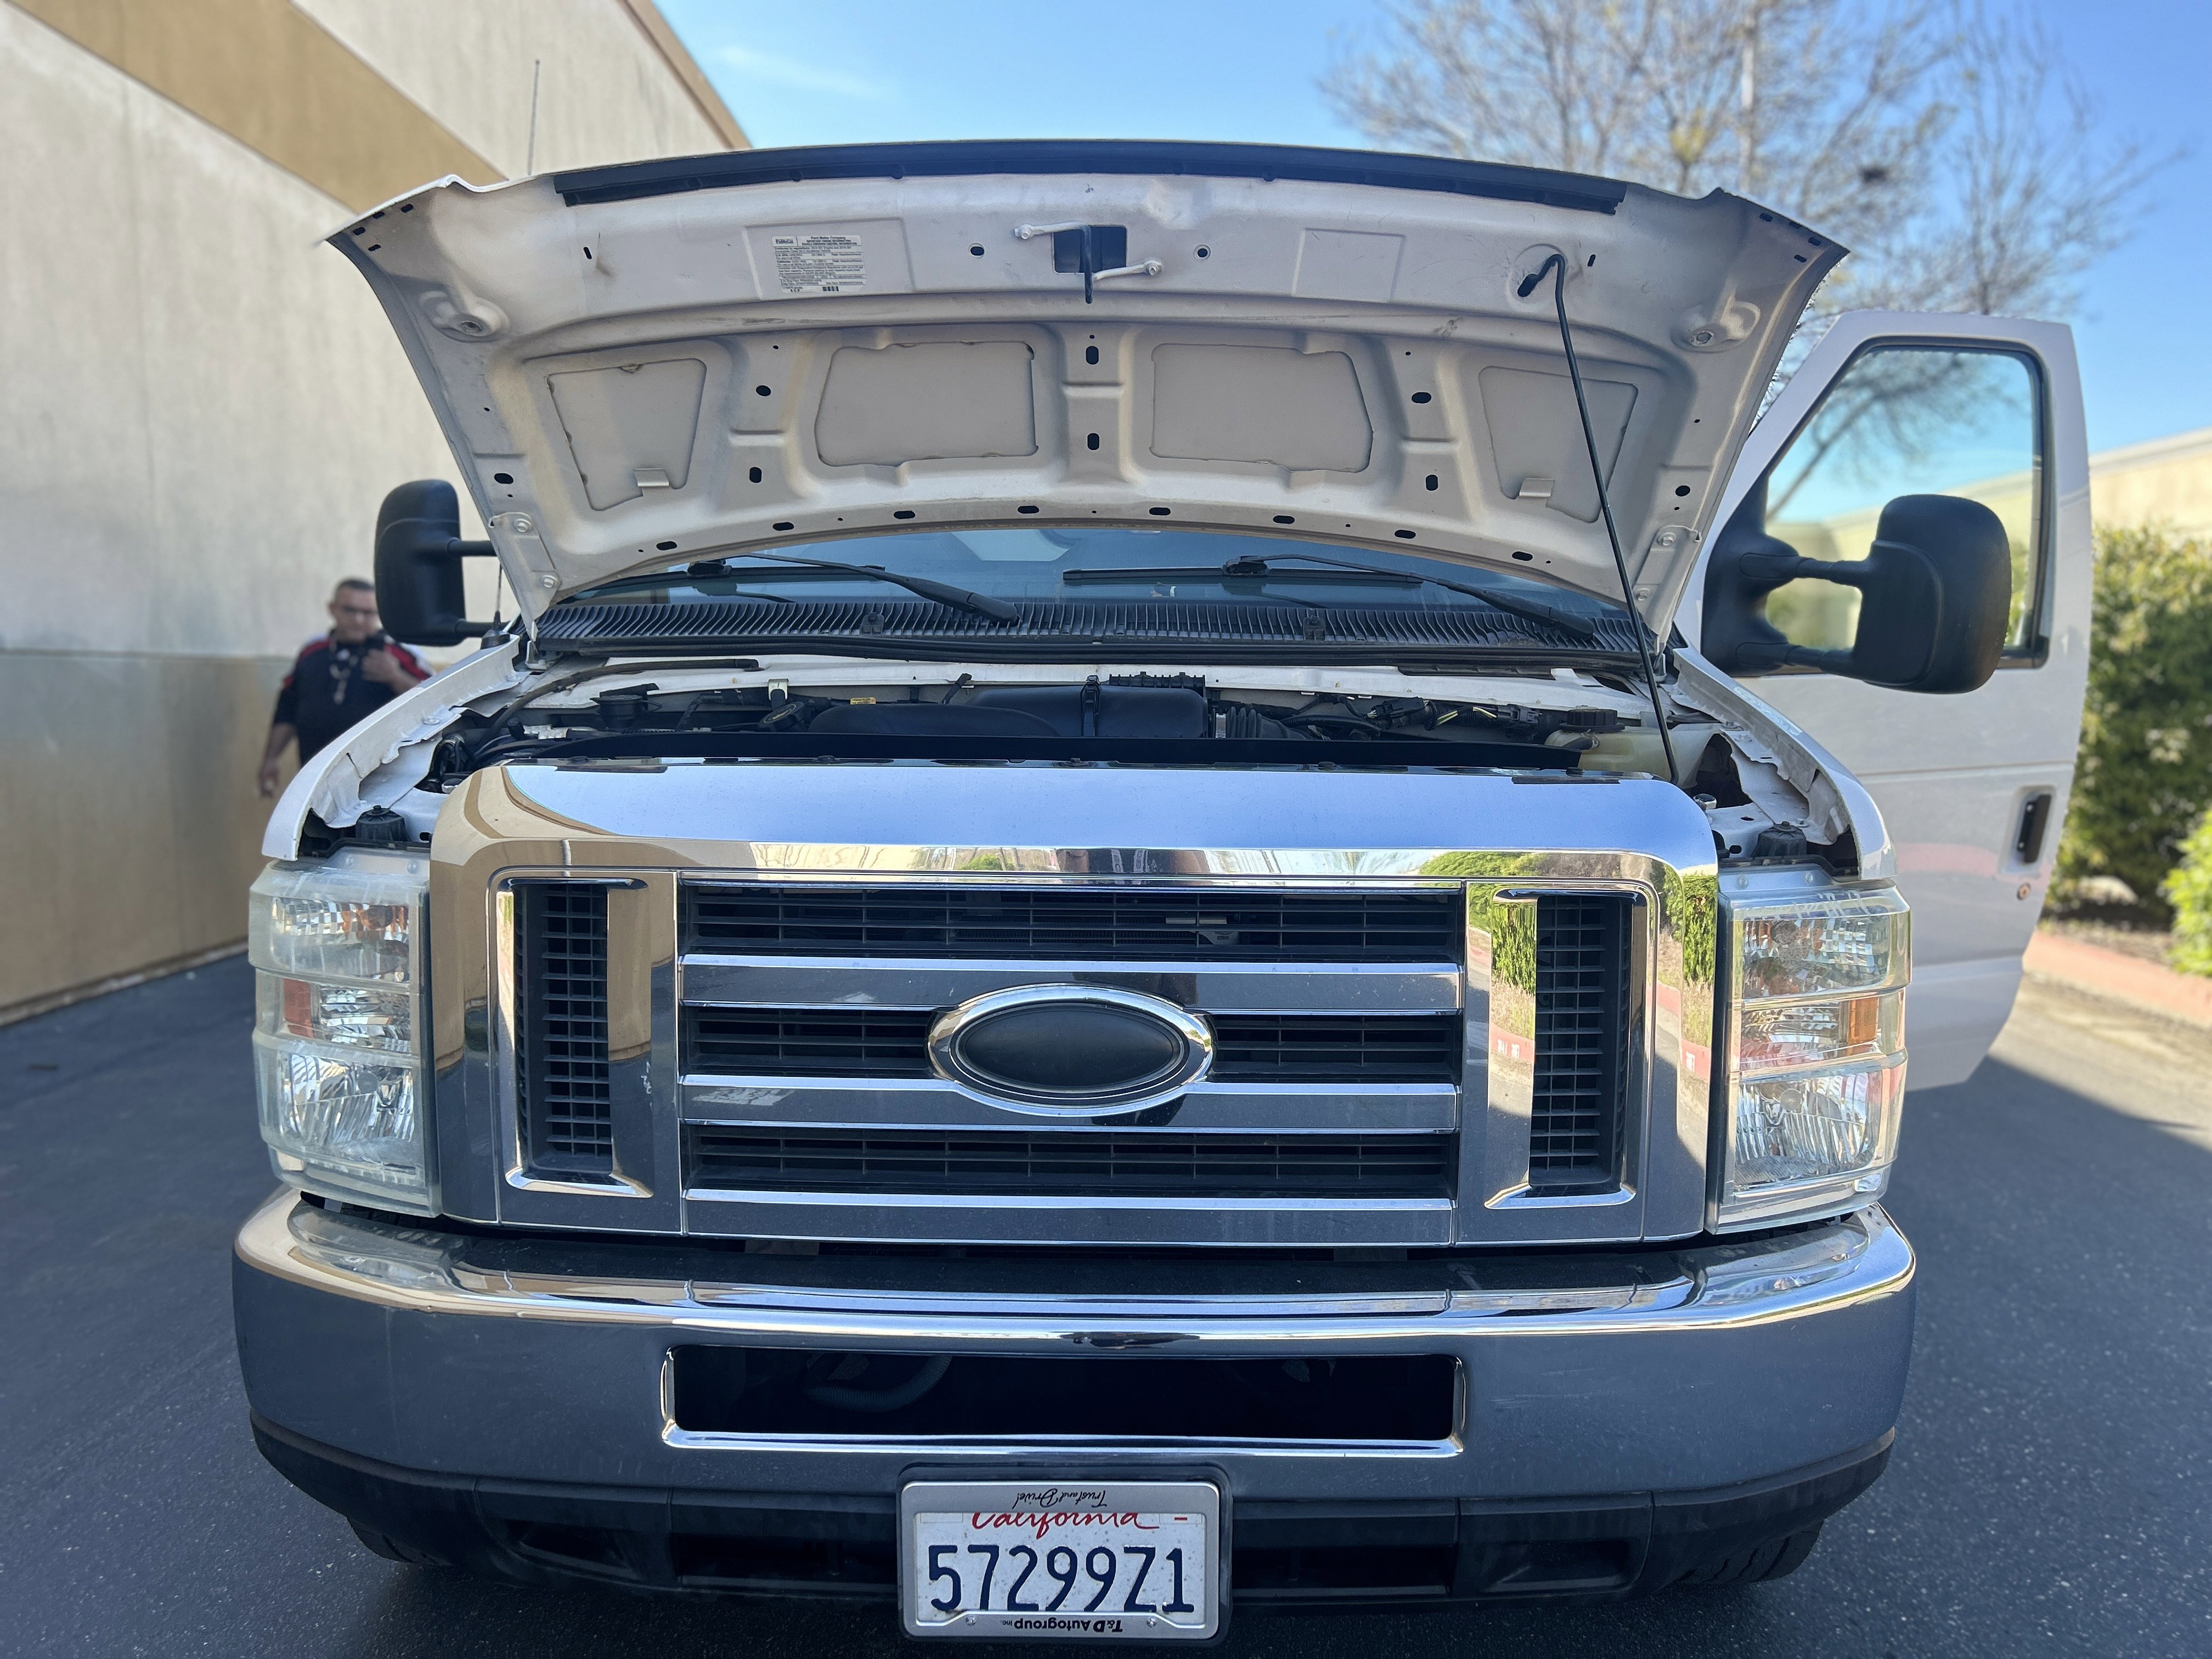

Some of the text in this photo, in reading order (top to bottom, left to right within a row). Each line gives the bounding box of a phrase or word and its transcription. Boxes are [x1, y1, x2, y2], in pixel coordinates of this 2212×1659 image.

[1011, 1488, 1108, 1510] Trust and Drive!
[928, 1544, 1195, 1612] 57299Z1
[1014, 1618, 1091, 1632] Autogroup
[1093, 1620, 1123, 1633] T&D
